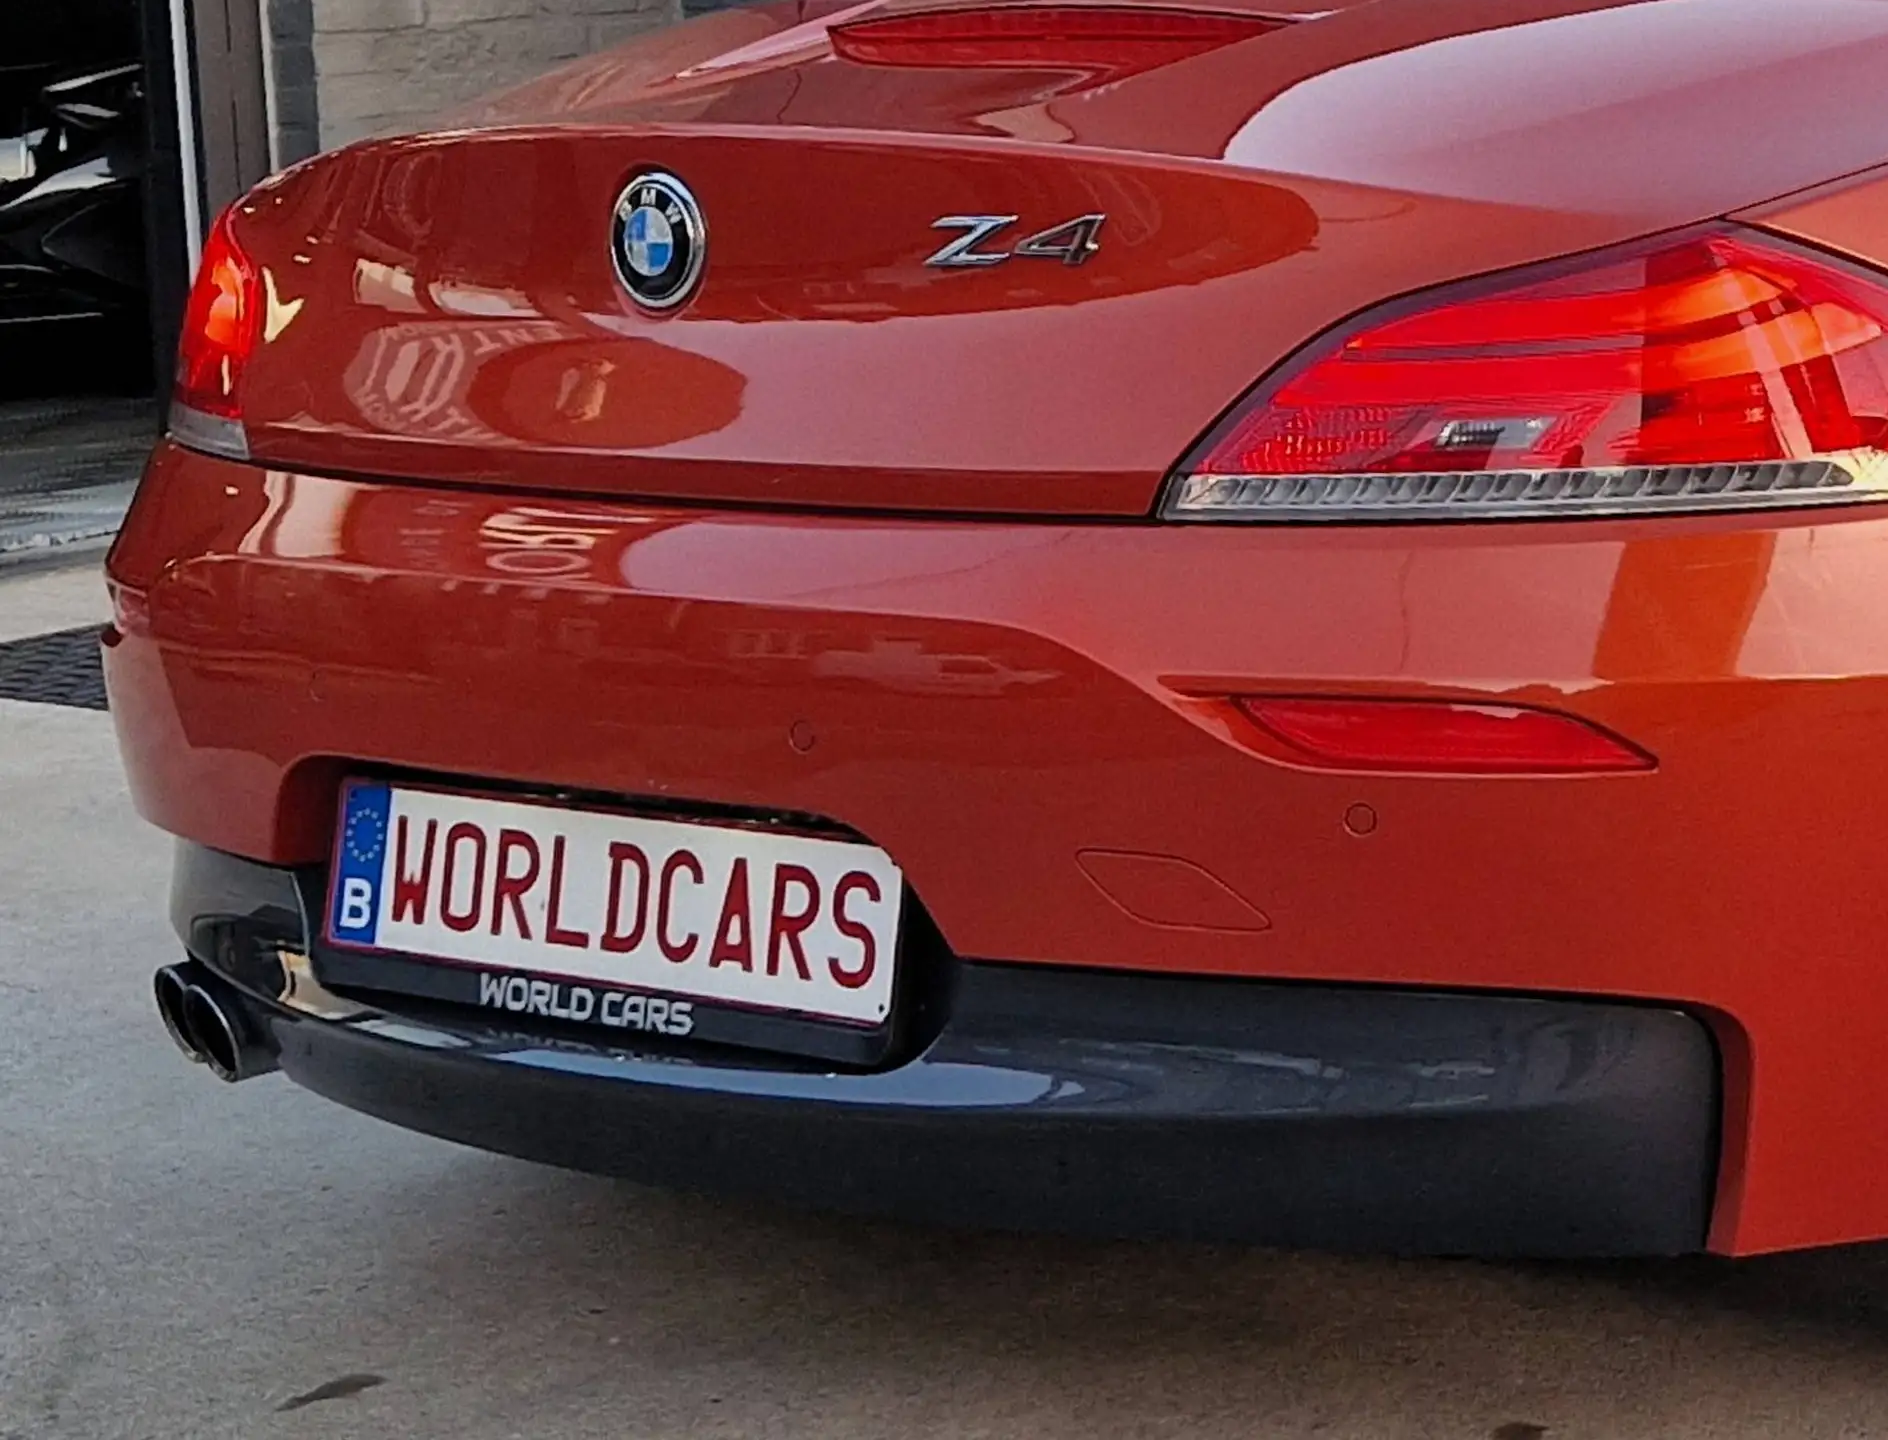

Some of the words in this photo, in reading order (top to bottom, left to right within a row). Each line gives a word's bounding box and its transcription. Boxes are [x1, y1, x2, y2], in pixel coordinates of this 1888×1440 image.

[619, 188, 682, 224] BMW
[923, 213, 1107, 267] Z4
[340, 877, 373, 930] B
[391, 814, 882, 990] WORLDCARS
[479, 972, 595, 1021] WORLD
[600, 992, 694, 1037] CARS
